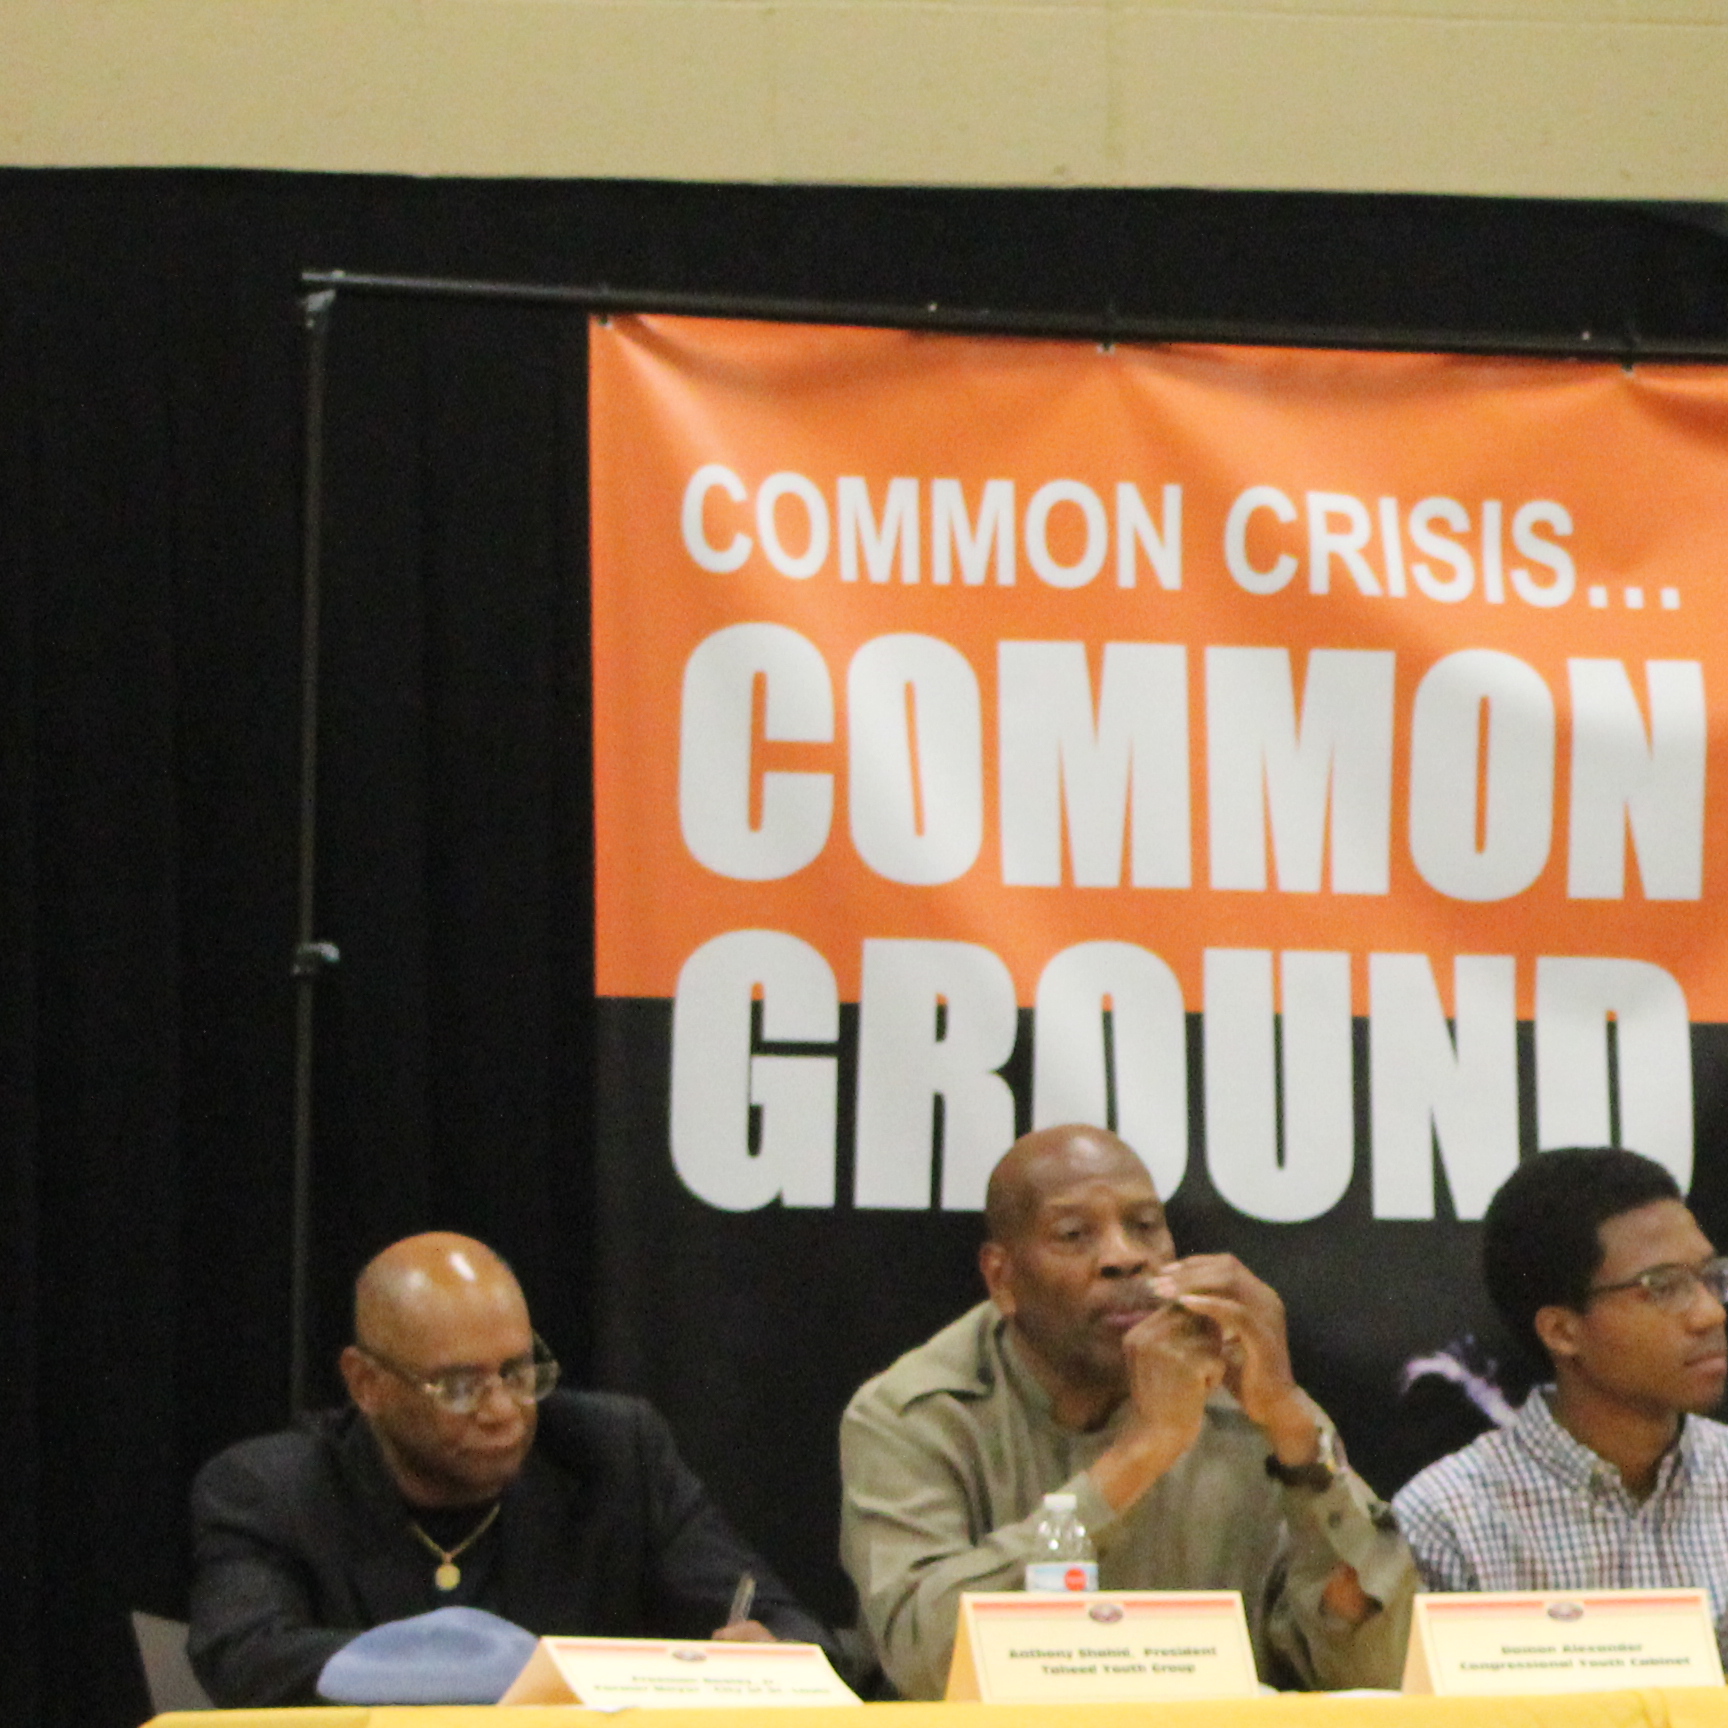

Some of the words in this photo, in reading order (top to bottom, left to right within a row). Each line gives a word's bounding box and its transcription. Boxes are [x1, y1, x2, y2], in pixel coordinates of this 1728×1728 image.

[681, 462, 1184, 591] COMMON
[1224, 485, 1681, 611] CRISIS...
[678, 621, 1707, 902] COMMON
[669, 928, 1693, 1224] GROUND
